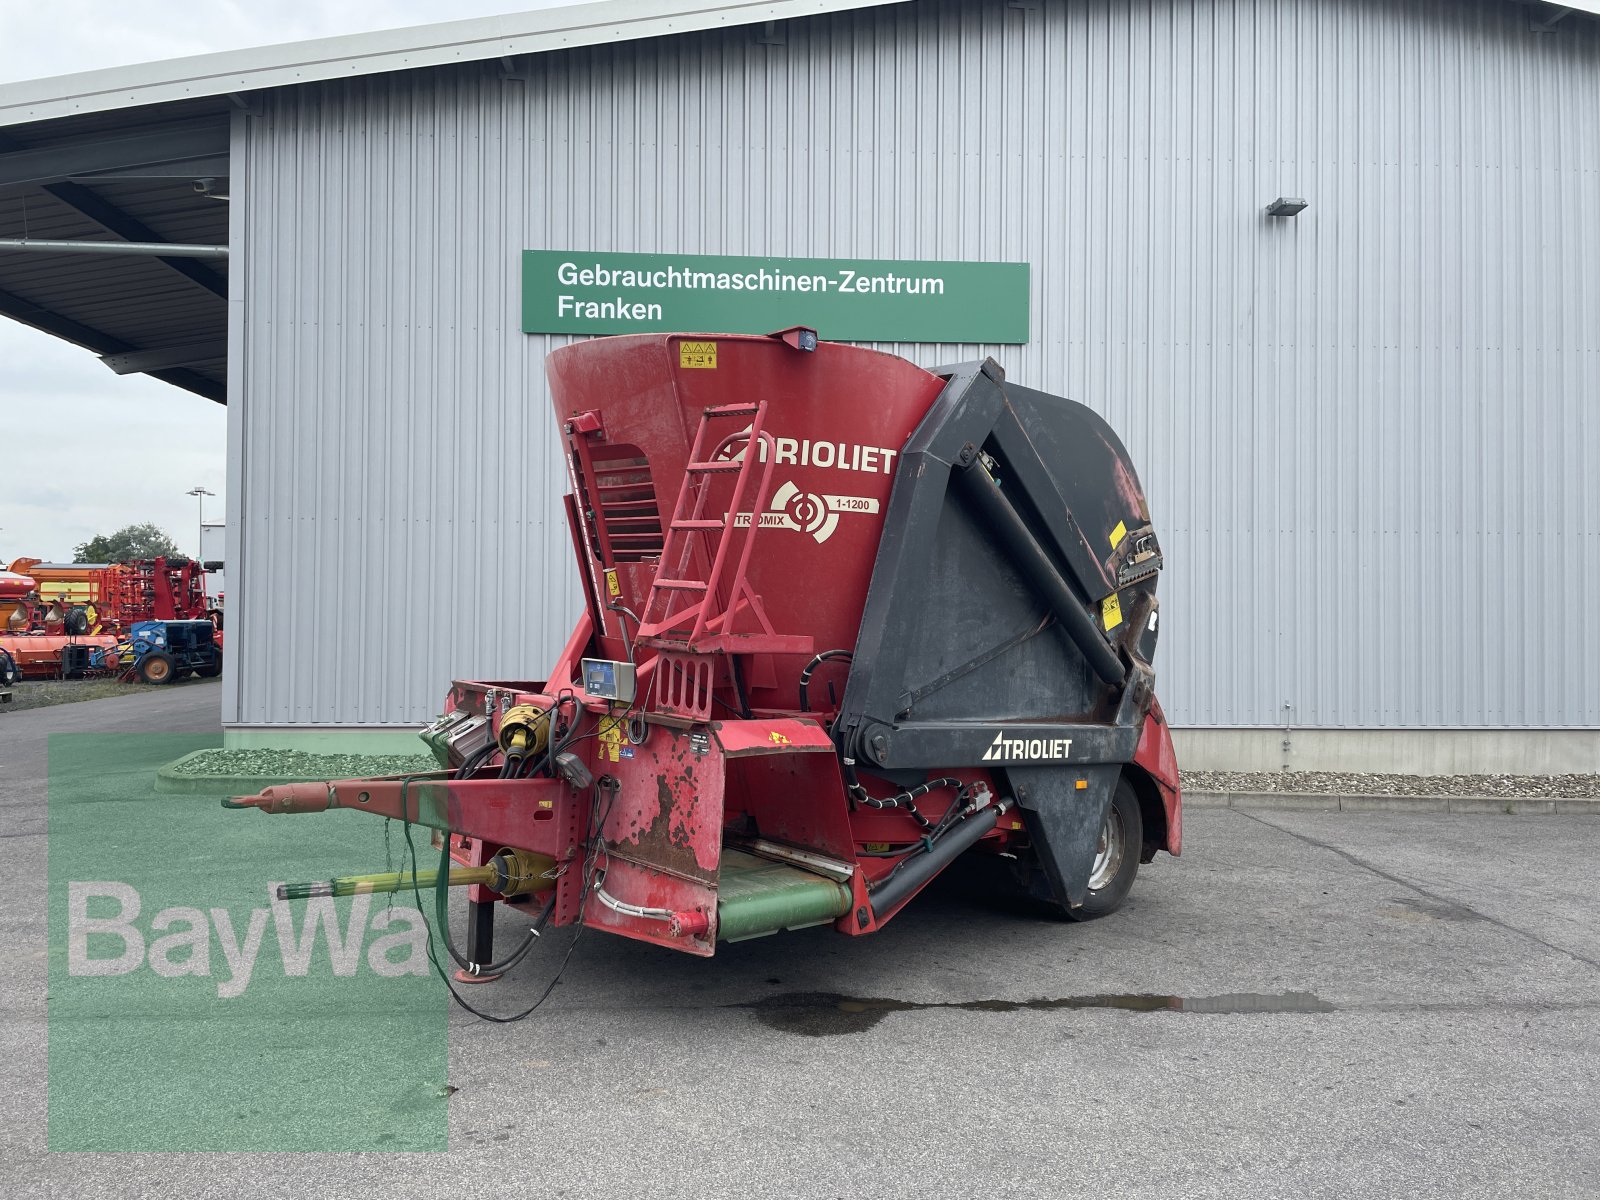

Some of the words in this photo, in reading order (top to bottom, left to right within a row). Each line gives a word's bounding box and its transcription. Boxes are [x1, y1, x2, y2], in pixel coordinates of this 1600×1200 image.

[557, 262, 944, 294] Gebrauchtmaschinen-Zentrum
[557, 295, 662, 320] Franken
[757, 438, 897, 475] TRIOLIET
[836, 499, 870, 510] 1-1200
[1002, 739, 1073, 760] TRIOLIET
